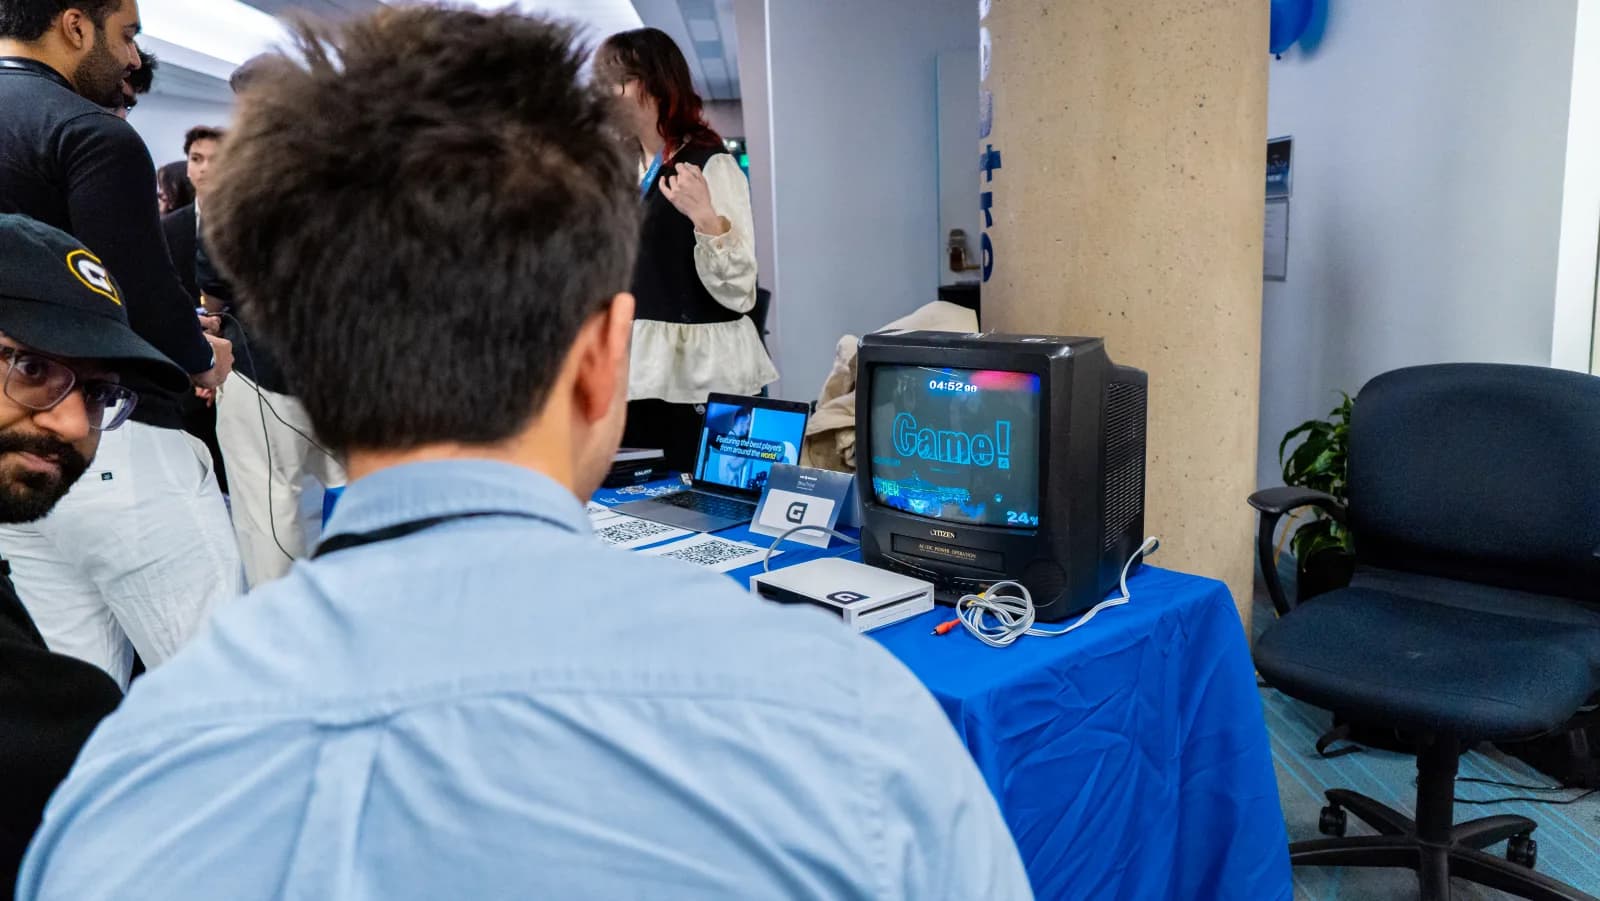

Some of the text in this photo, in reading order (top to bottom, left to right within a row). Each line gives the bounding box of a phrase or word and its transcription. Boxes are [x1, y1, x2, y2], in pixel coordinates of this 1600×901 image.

[929, 380, 963, 392] 04:52
[716, 435, 740, 447] Featuring
[750, 440, 762, 448] best
[762, 441, 782, 452] players
[893, 412, 1011, 469] Game!
[733, 447, 751, 456] around
[761, 452, 776, 460] world
[929, 529, 955, 539] CITIZEN
